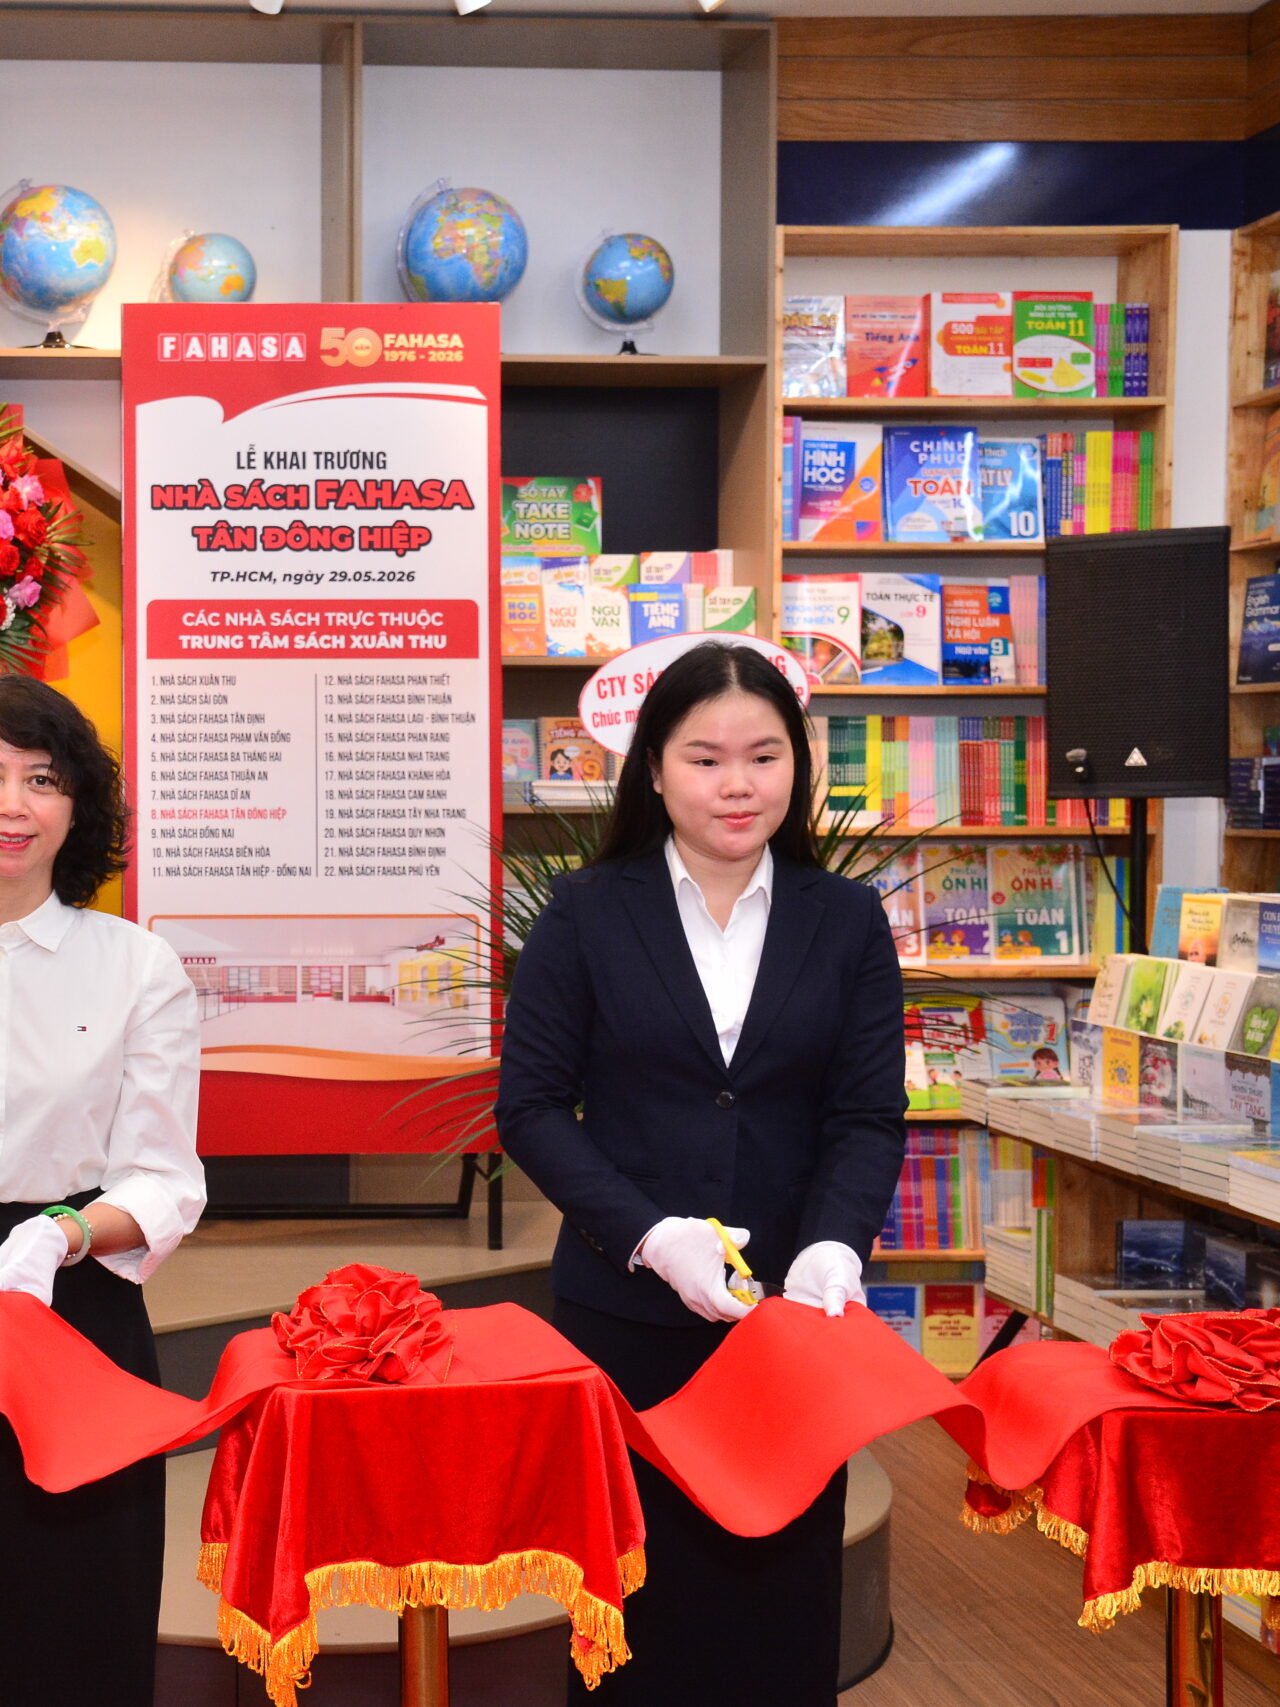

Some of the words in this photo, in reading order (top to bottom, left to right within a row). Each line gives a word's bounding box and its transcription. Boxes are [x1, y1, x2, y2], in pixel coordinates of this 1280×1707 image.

[1026, 319, 1066, 331] TOÁN
[1068, 320, 1085, 336] 11
[161, 335, 305, 360] FAHASA
[320, 327, 383, 367] 50
[384, 334, 464, 349] FAHASA
[384, 350, 416, 362] 1976
[428, 350, 464, 362] 2026
[236, 443, 257, 469] LỄ
[264, 450, 307, 470] KHAI
[314, 449, 387, 470] TRƯƠNG
[151, 478, 222, 510] NHÀ
[224, 479, 308, 510] SÁCH
[315, 479, 474, 510] FAHASA
[513, 501, 571, 521] TAKE
[513, 521, 571, 540] NOTE
[1008, 511, 1036, 536] 10
[192, 519, 257, 551] TÂN
[260, 519, 353, 552] ĐÔNG
[358, 519, 432, 557] HIỆP
[210, 571, 278, 585] TP.HCM,
[283, 571, 324, 585] ngày
[329, 571, 416, 583] 29.05.2026
[865, 592, 891, 601] TOÁN
[182, 608, 220, 626] CÁC
[225, 608, 265, 626] NHÀ
[271, 608, 320, 626] SÁCH
[325, 611, 374, 630] TRỰC
[379, 609, 444, 629] THUỘC
[837, 606, 850, 624] 9
[915, 605, 927, 618] 9
[179, 634, 244, 649] TRUNG
[248, 631, 289, 649] TÂM
[294, 631, 346, 650] SÁCH
[350, 631, 403, 650] XUÂN
[408, 635, 447, 649] THU
[991, 639, 1004, 655] 9
[596, 674, 627, 699] CTY
[633, 667, 664, 694] SÁ
[592, 708, 622, 728] Chúc
[200, 732, 228, 743] FAHASA
[583, 759, 602, 781] 9
[198, 808, 230, 819] FAHASA
[377, 807, 406, 819] FAHASA
[424, 808, 440, 818] NHA
[442, 808, 466, 818] TRANG
[1014, 907, 1065, 925] TOÁN
[904, 936, 919, 955] 3
[1055, 930, 1069, 954] 1
